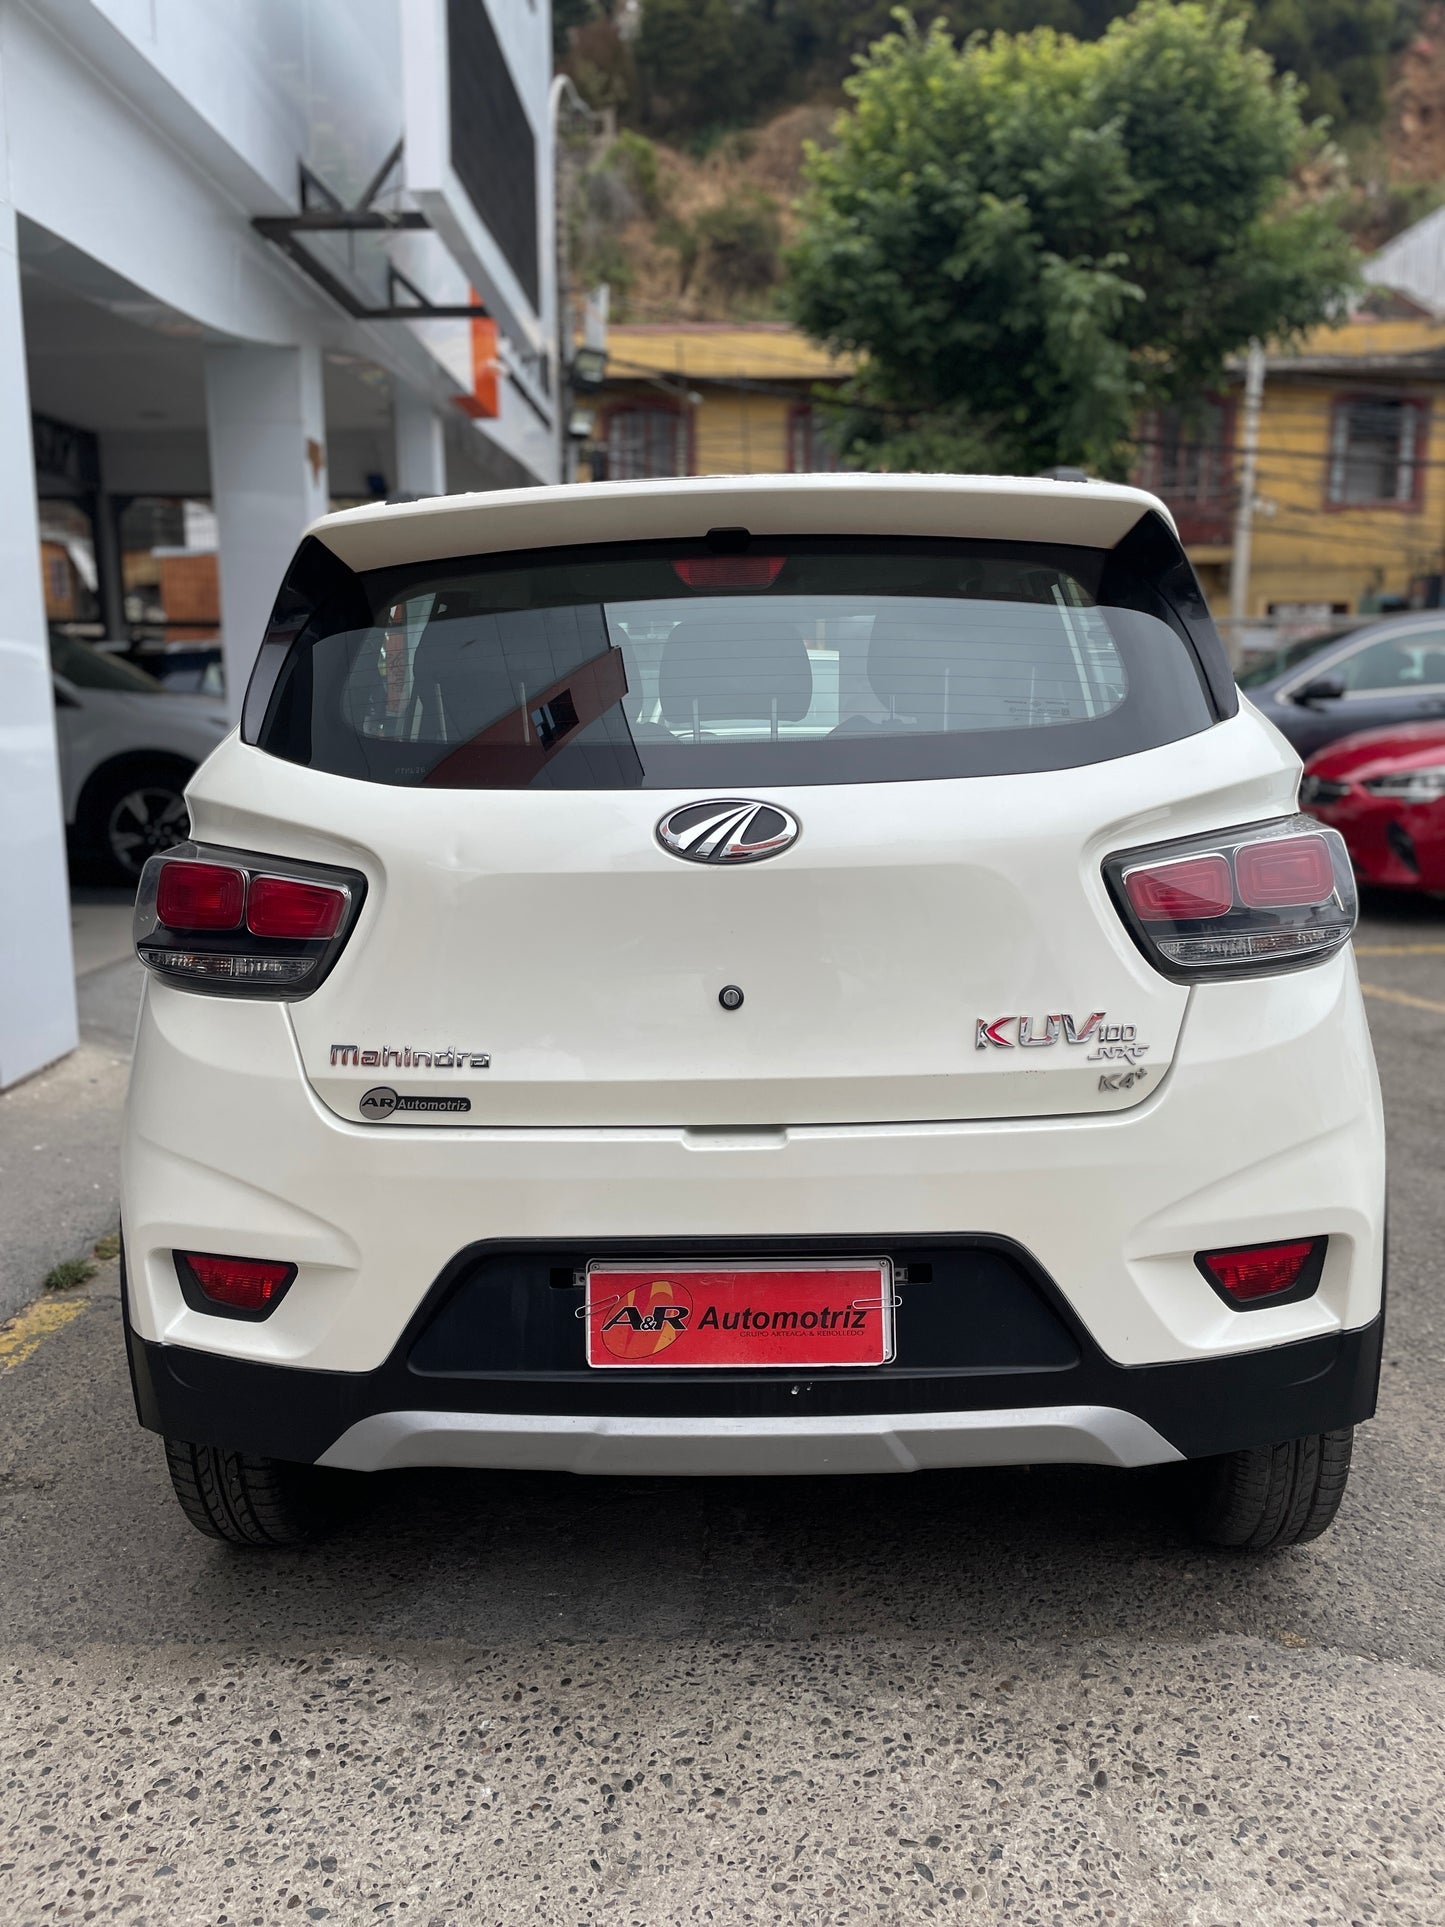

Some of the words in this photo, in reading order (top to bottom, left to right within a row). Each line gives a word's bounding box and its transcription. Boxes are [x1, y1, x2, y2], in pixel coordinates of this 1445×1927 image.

[975, 1012, 1107, 1050] KUV
[1098, 1023, 1138, 1043] 100
[330, 1044, 491, 1070] Mahindra
[361, 1097, 396, 1108] AR
[397, 1098, 468, 1111] Automotriz
[601, 1305, 690, 1332] A&R
[697, 1305, 866, 1329] Automotriz
[739, 1330, 770, 1338] GRUPO
